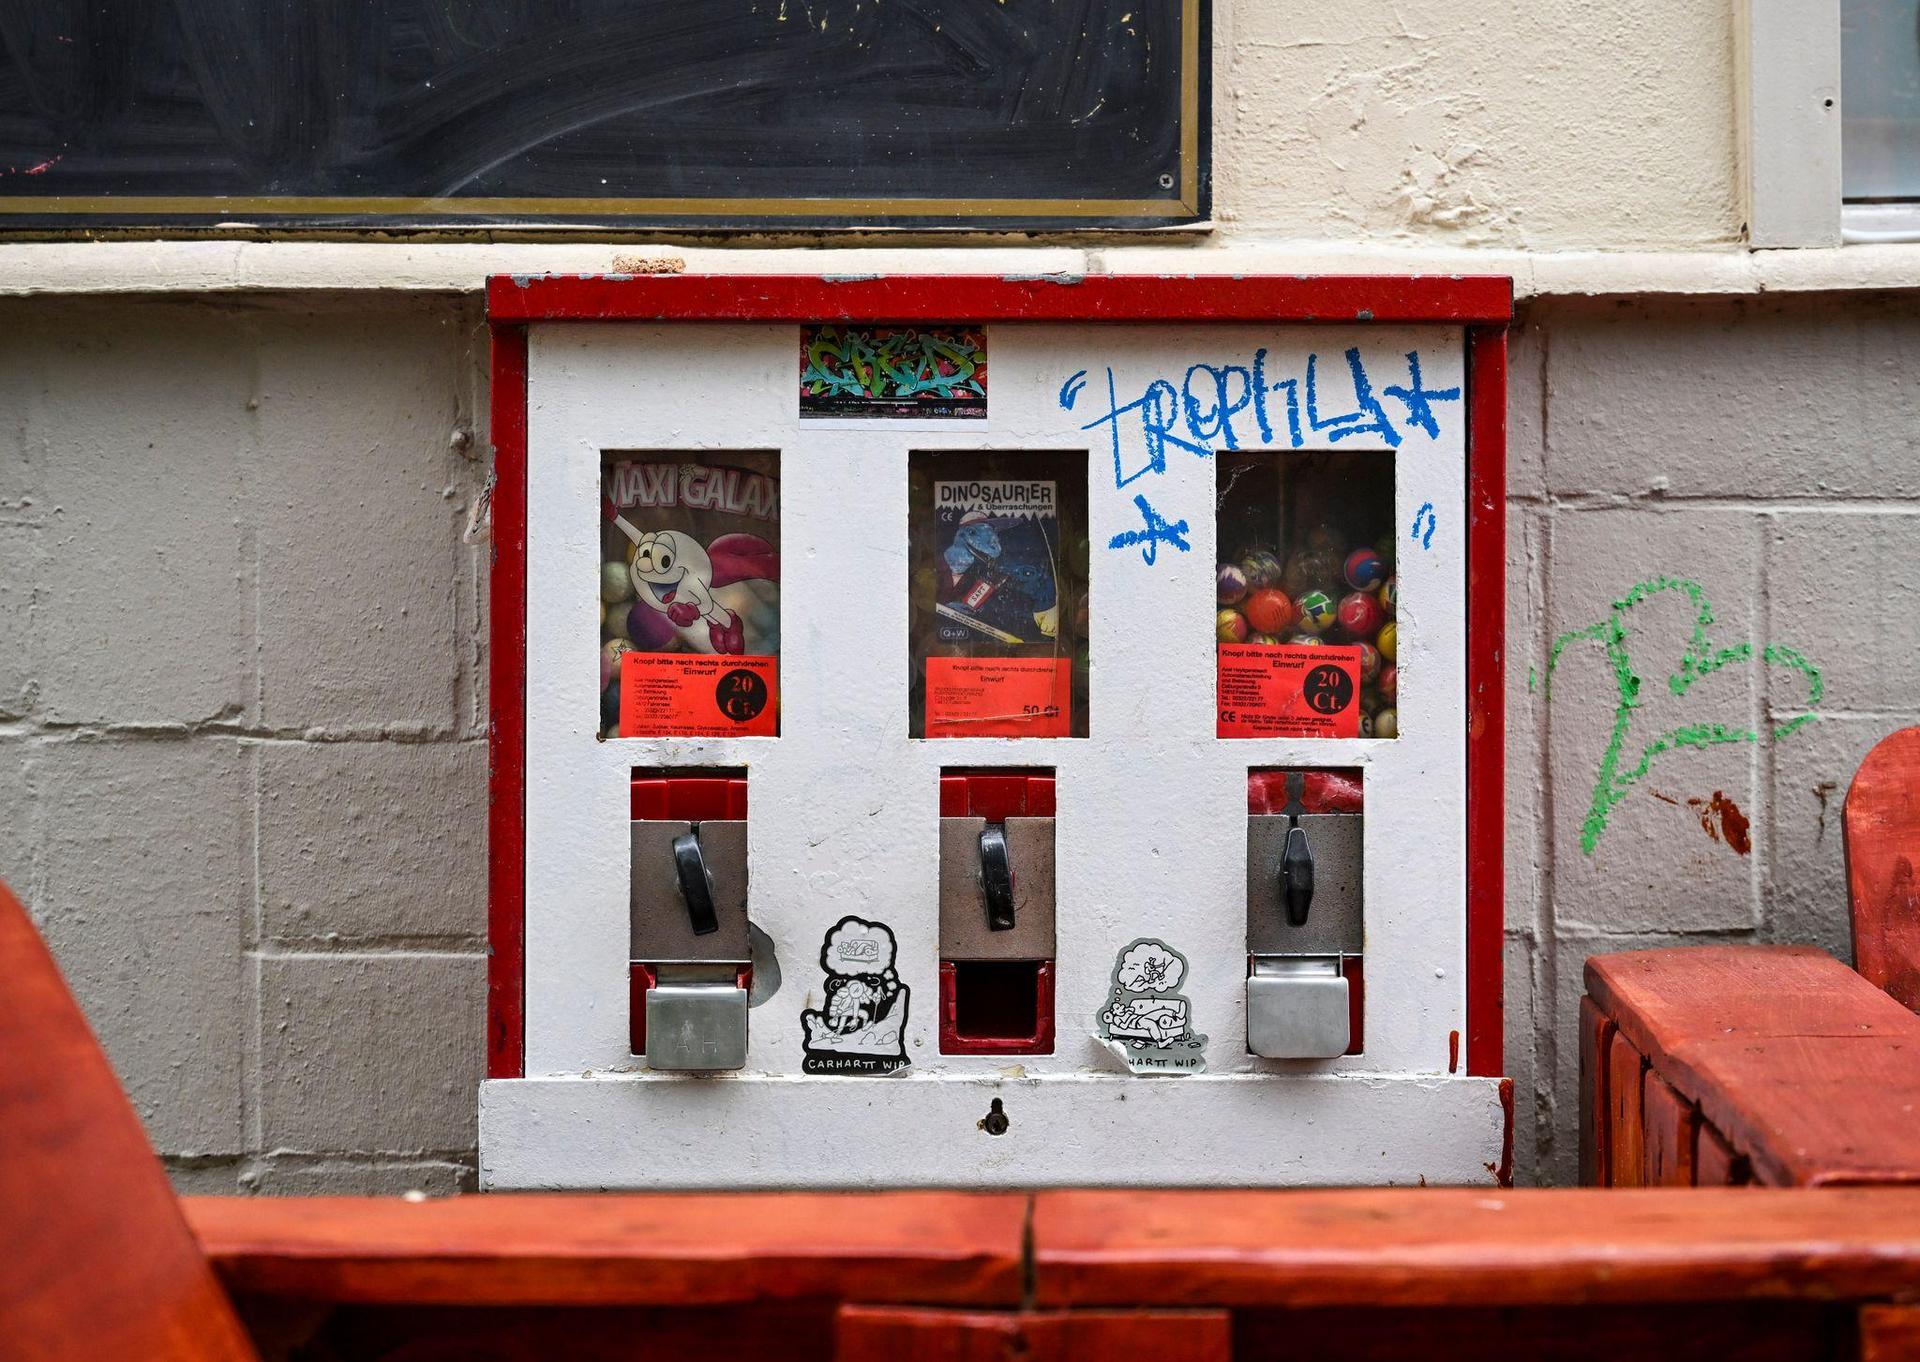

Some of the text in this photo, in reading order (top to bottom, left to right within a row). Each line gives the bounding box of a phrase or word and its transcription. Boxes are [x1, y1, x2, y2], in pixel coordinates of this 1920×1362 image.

[941, 482, 1052, 503] DINOSAURIER
[986, 502, 1053, 511] Überraschungen
[1222, 650, 1245, 659] Knopf
[1309, 654, 1356, 662] durchdrehen
[633, 658, 655, 667] Knopf
[657, 658, 673, 666] bitte
[721, 660, 769, 668] durchdrehen
[1272, 661, 1305, 669] Einwurf
[683, 667, 717, 676] Einwurf
[731, 676, 753, 693] 20
[980, 675, 1005, 683] Einwurf
[1318, 671, 1340, 687] 20
[1313, 692, 1343, 710] Ct.
[1023, 705, 1040, 717] 50
[1220, 711, 1236, 723] CE
[808, 1059, 905, 1070] CARHARTT WIP
[1128, 1058, 1197, 1067] HARTT WIP
